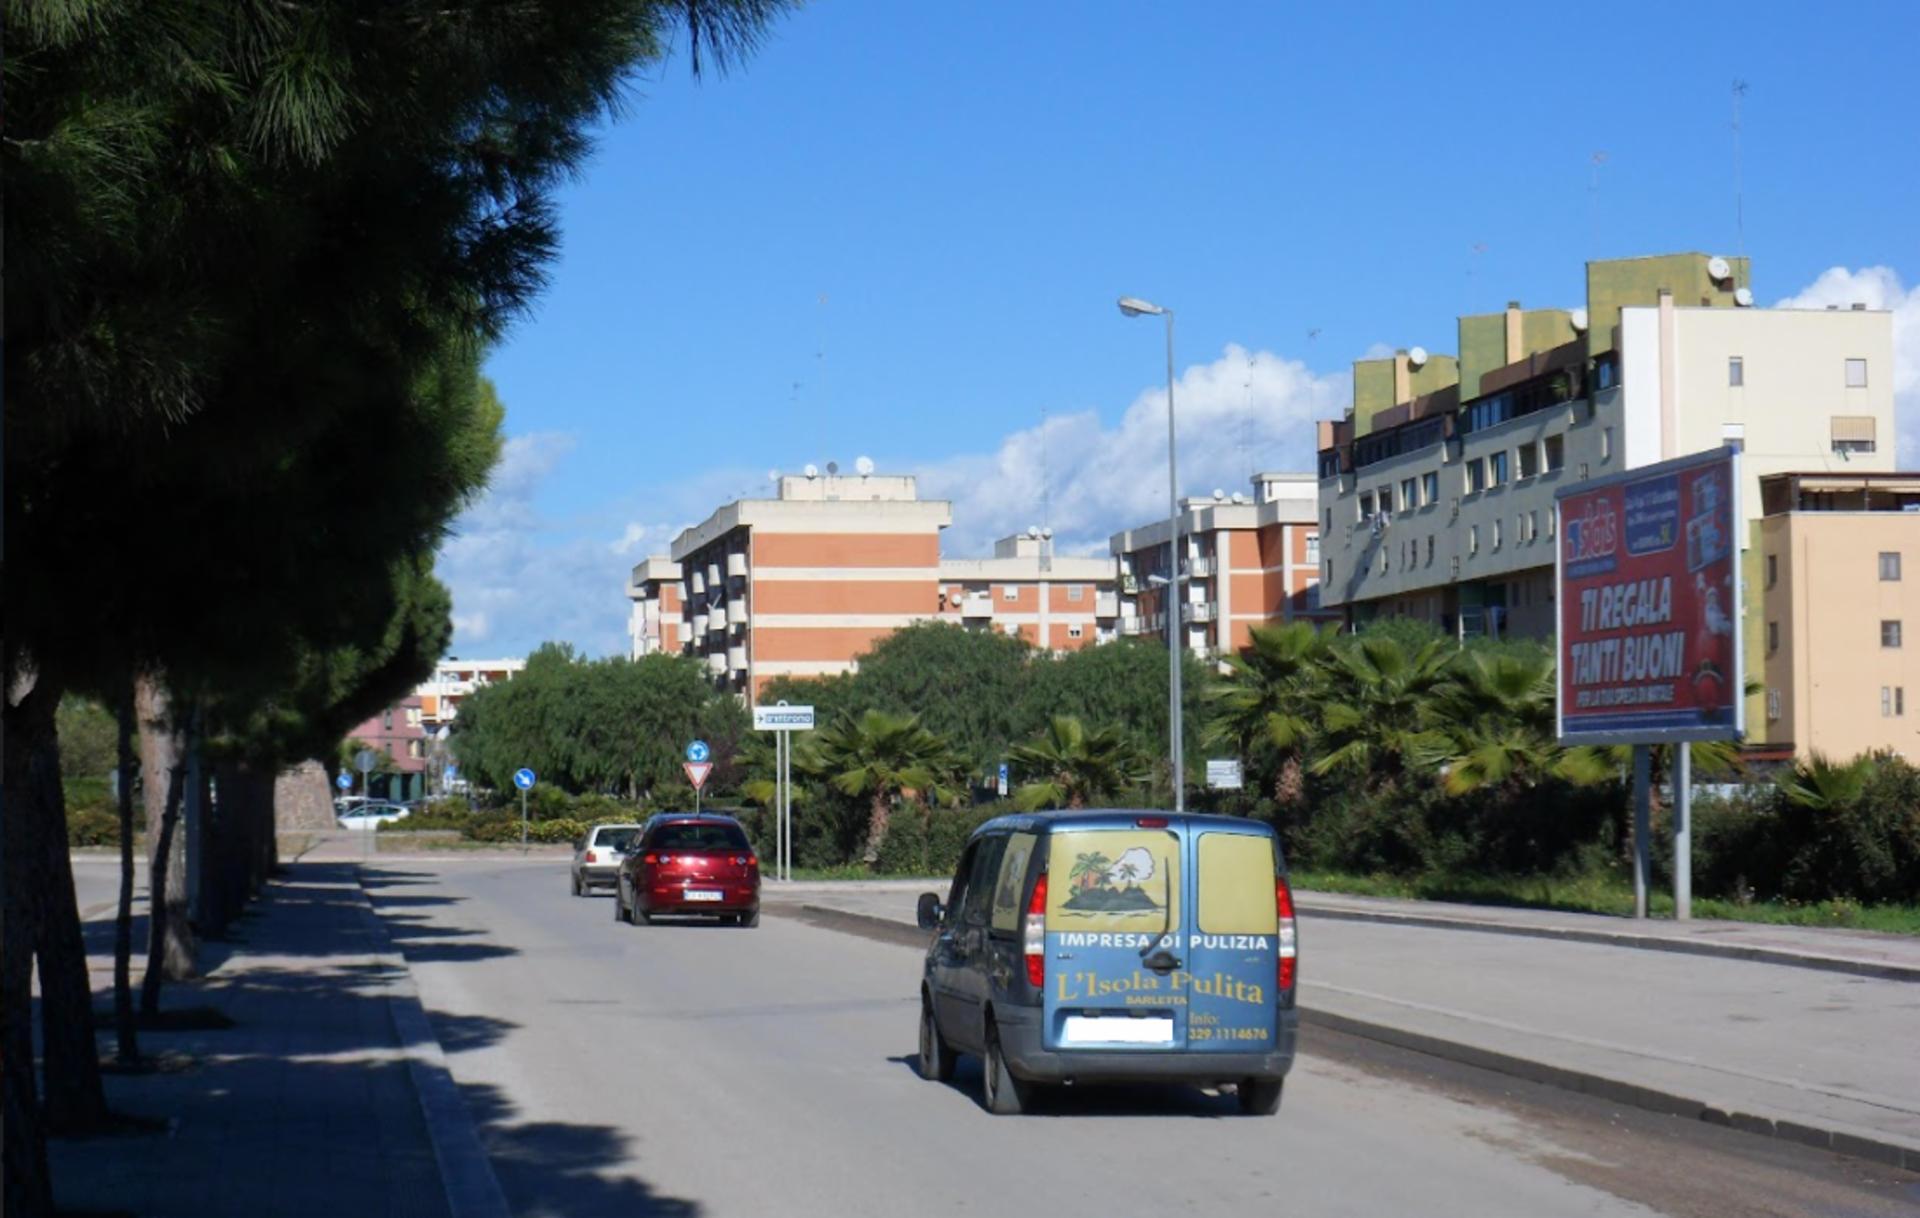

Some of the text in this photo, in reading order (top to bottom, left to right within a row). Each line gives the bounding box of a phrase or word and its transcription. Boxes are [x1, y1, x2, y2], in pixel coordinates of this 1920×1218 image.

[1581, 576, 1672, 632] TI REGALA
[1571, 632, 1685, 685] TANTI BUONI
[1060, 933, 1269, 950] IMPRESA DI PULIZIA
[1056, 971, 1264, 1005] L'Isola Pulita
